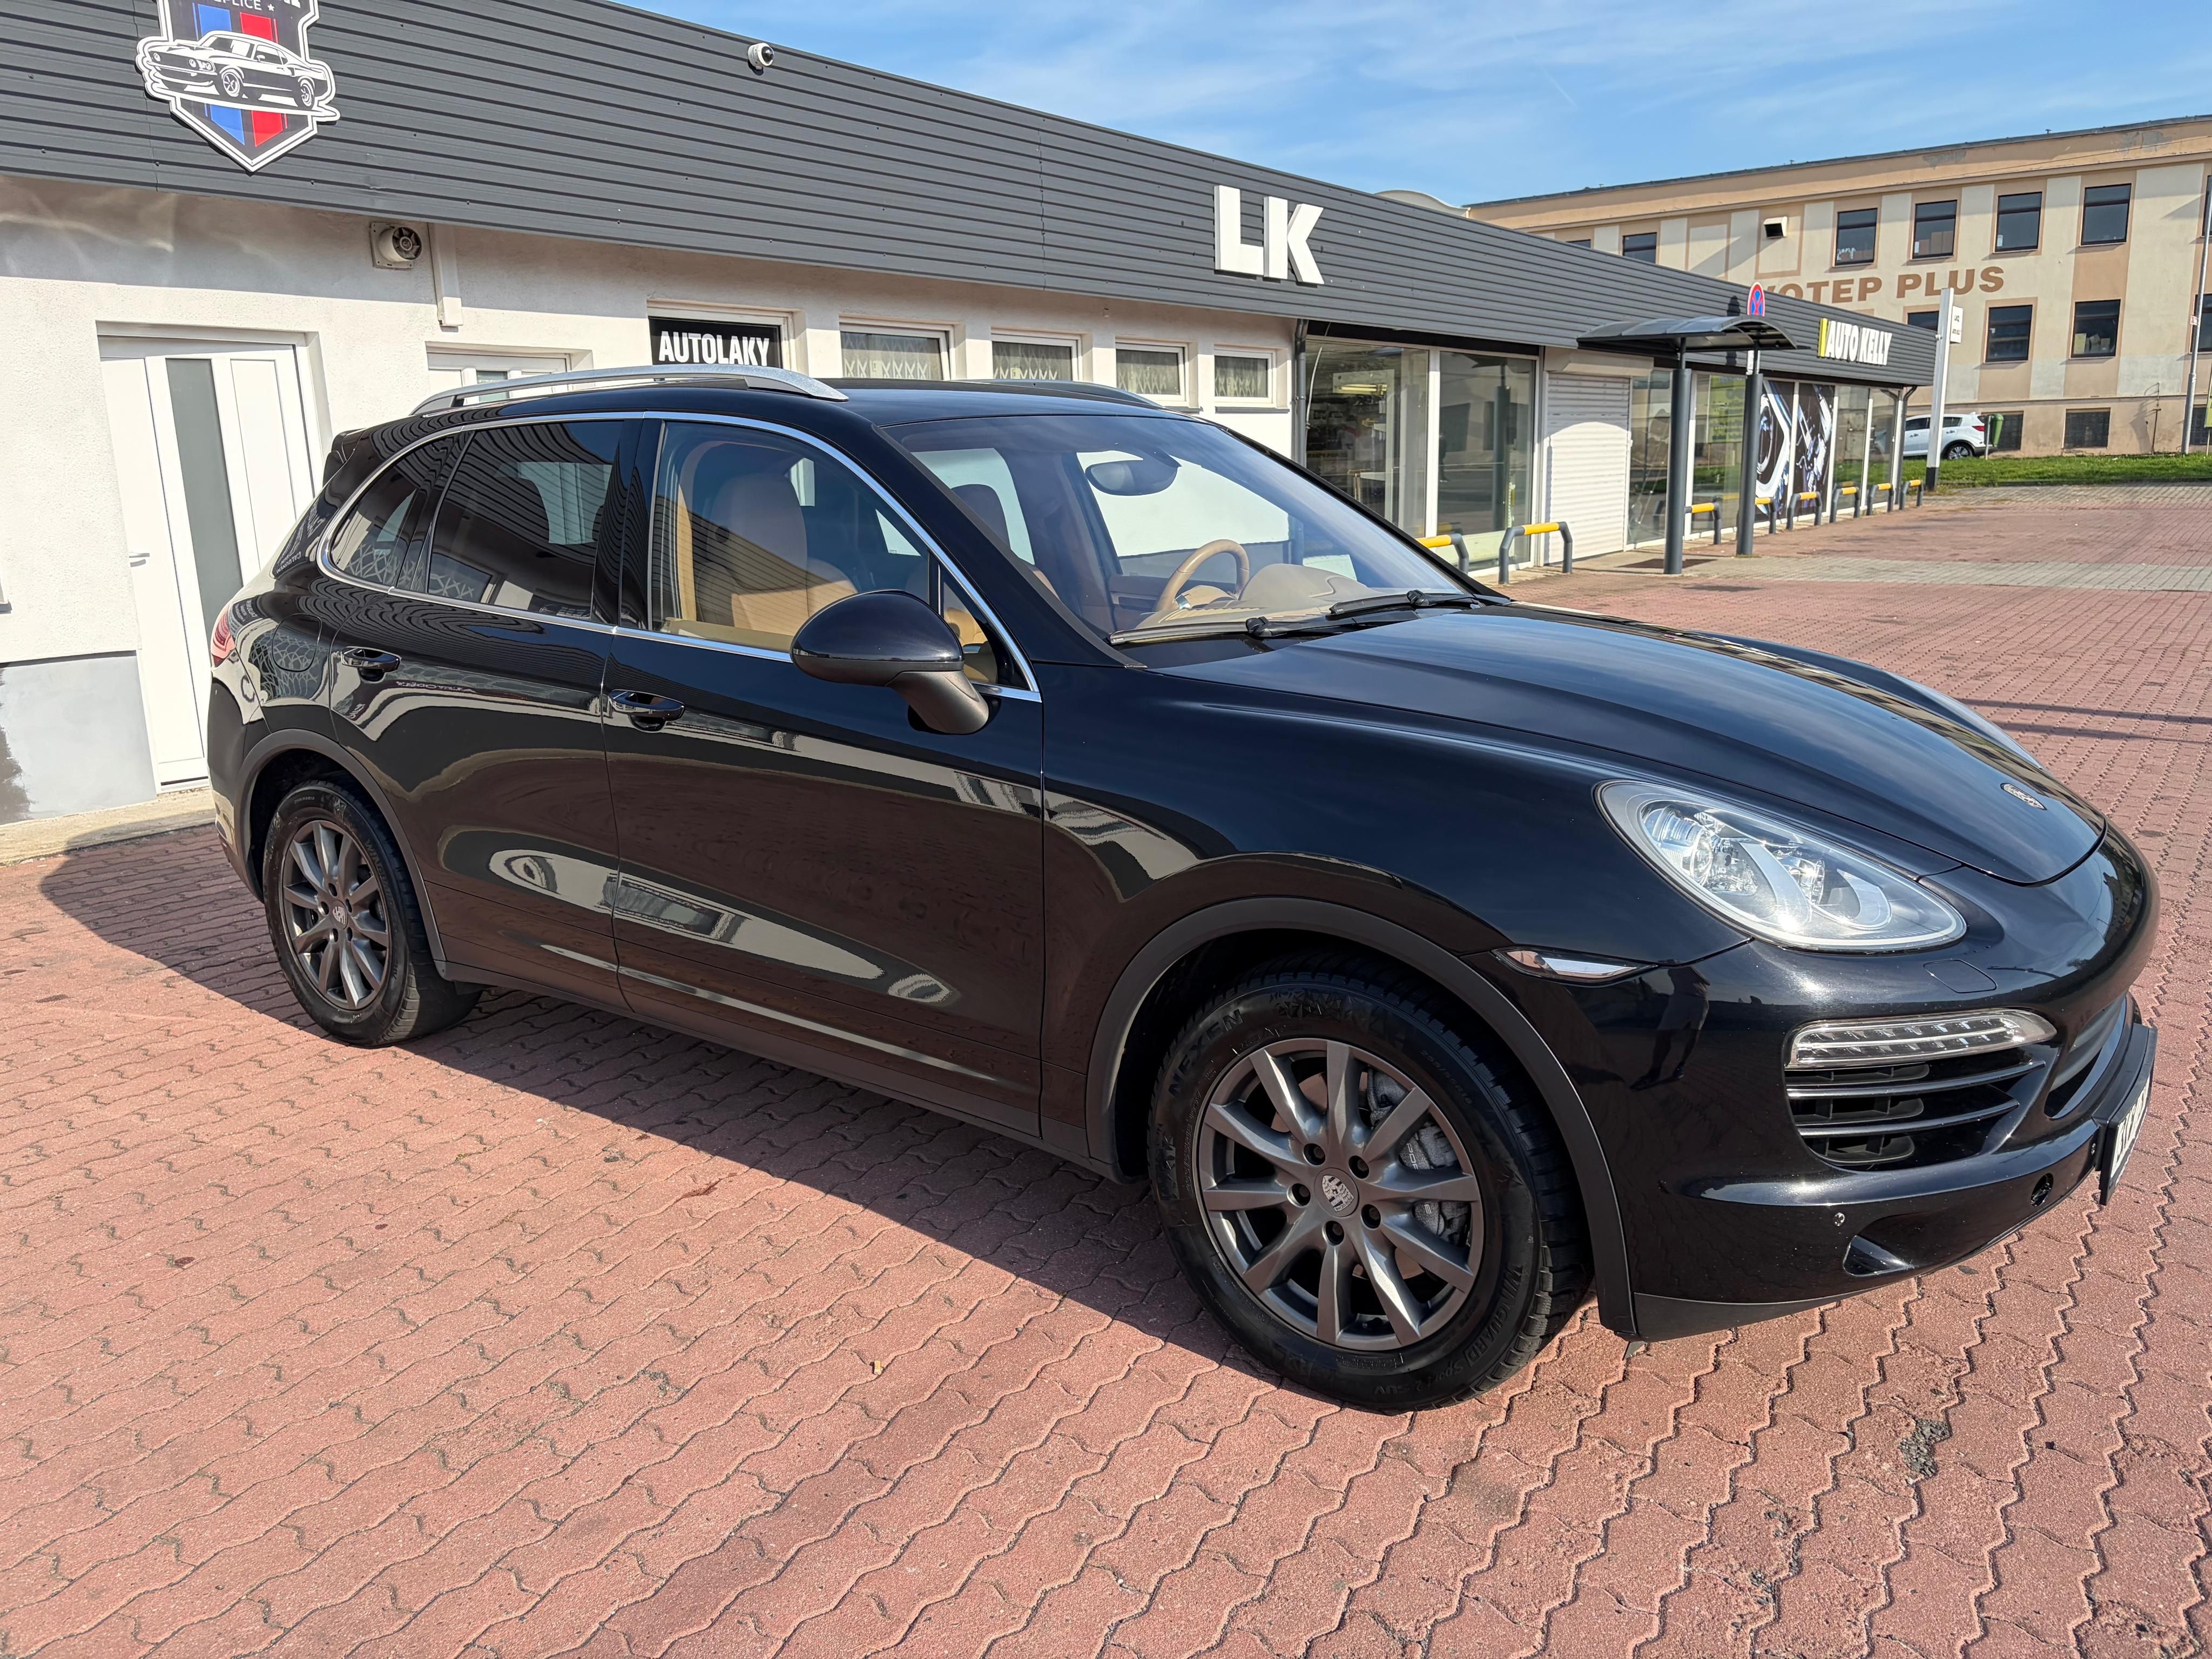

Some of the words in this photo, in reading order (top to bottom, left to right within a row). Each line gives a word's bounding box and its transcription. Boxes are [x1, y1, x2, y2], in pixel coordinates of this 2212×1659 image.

[1213, 185, 1325, 285] LK
[1896, 266, 2004, 299] PLUS
[658, 331, 770, 367] AUTOLAKY
[1825, 320, 1859, 362] AUTO
[1858, 327, 1892, 366] KELLY
[1168, 1008, 1245, 1098] NEXEN
[1419, 1049, 1473, 1105] 255/55R18
[1462, 1264, 1523, 1368] WINGUARD
